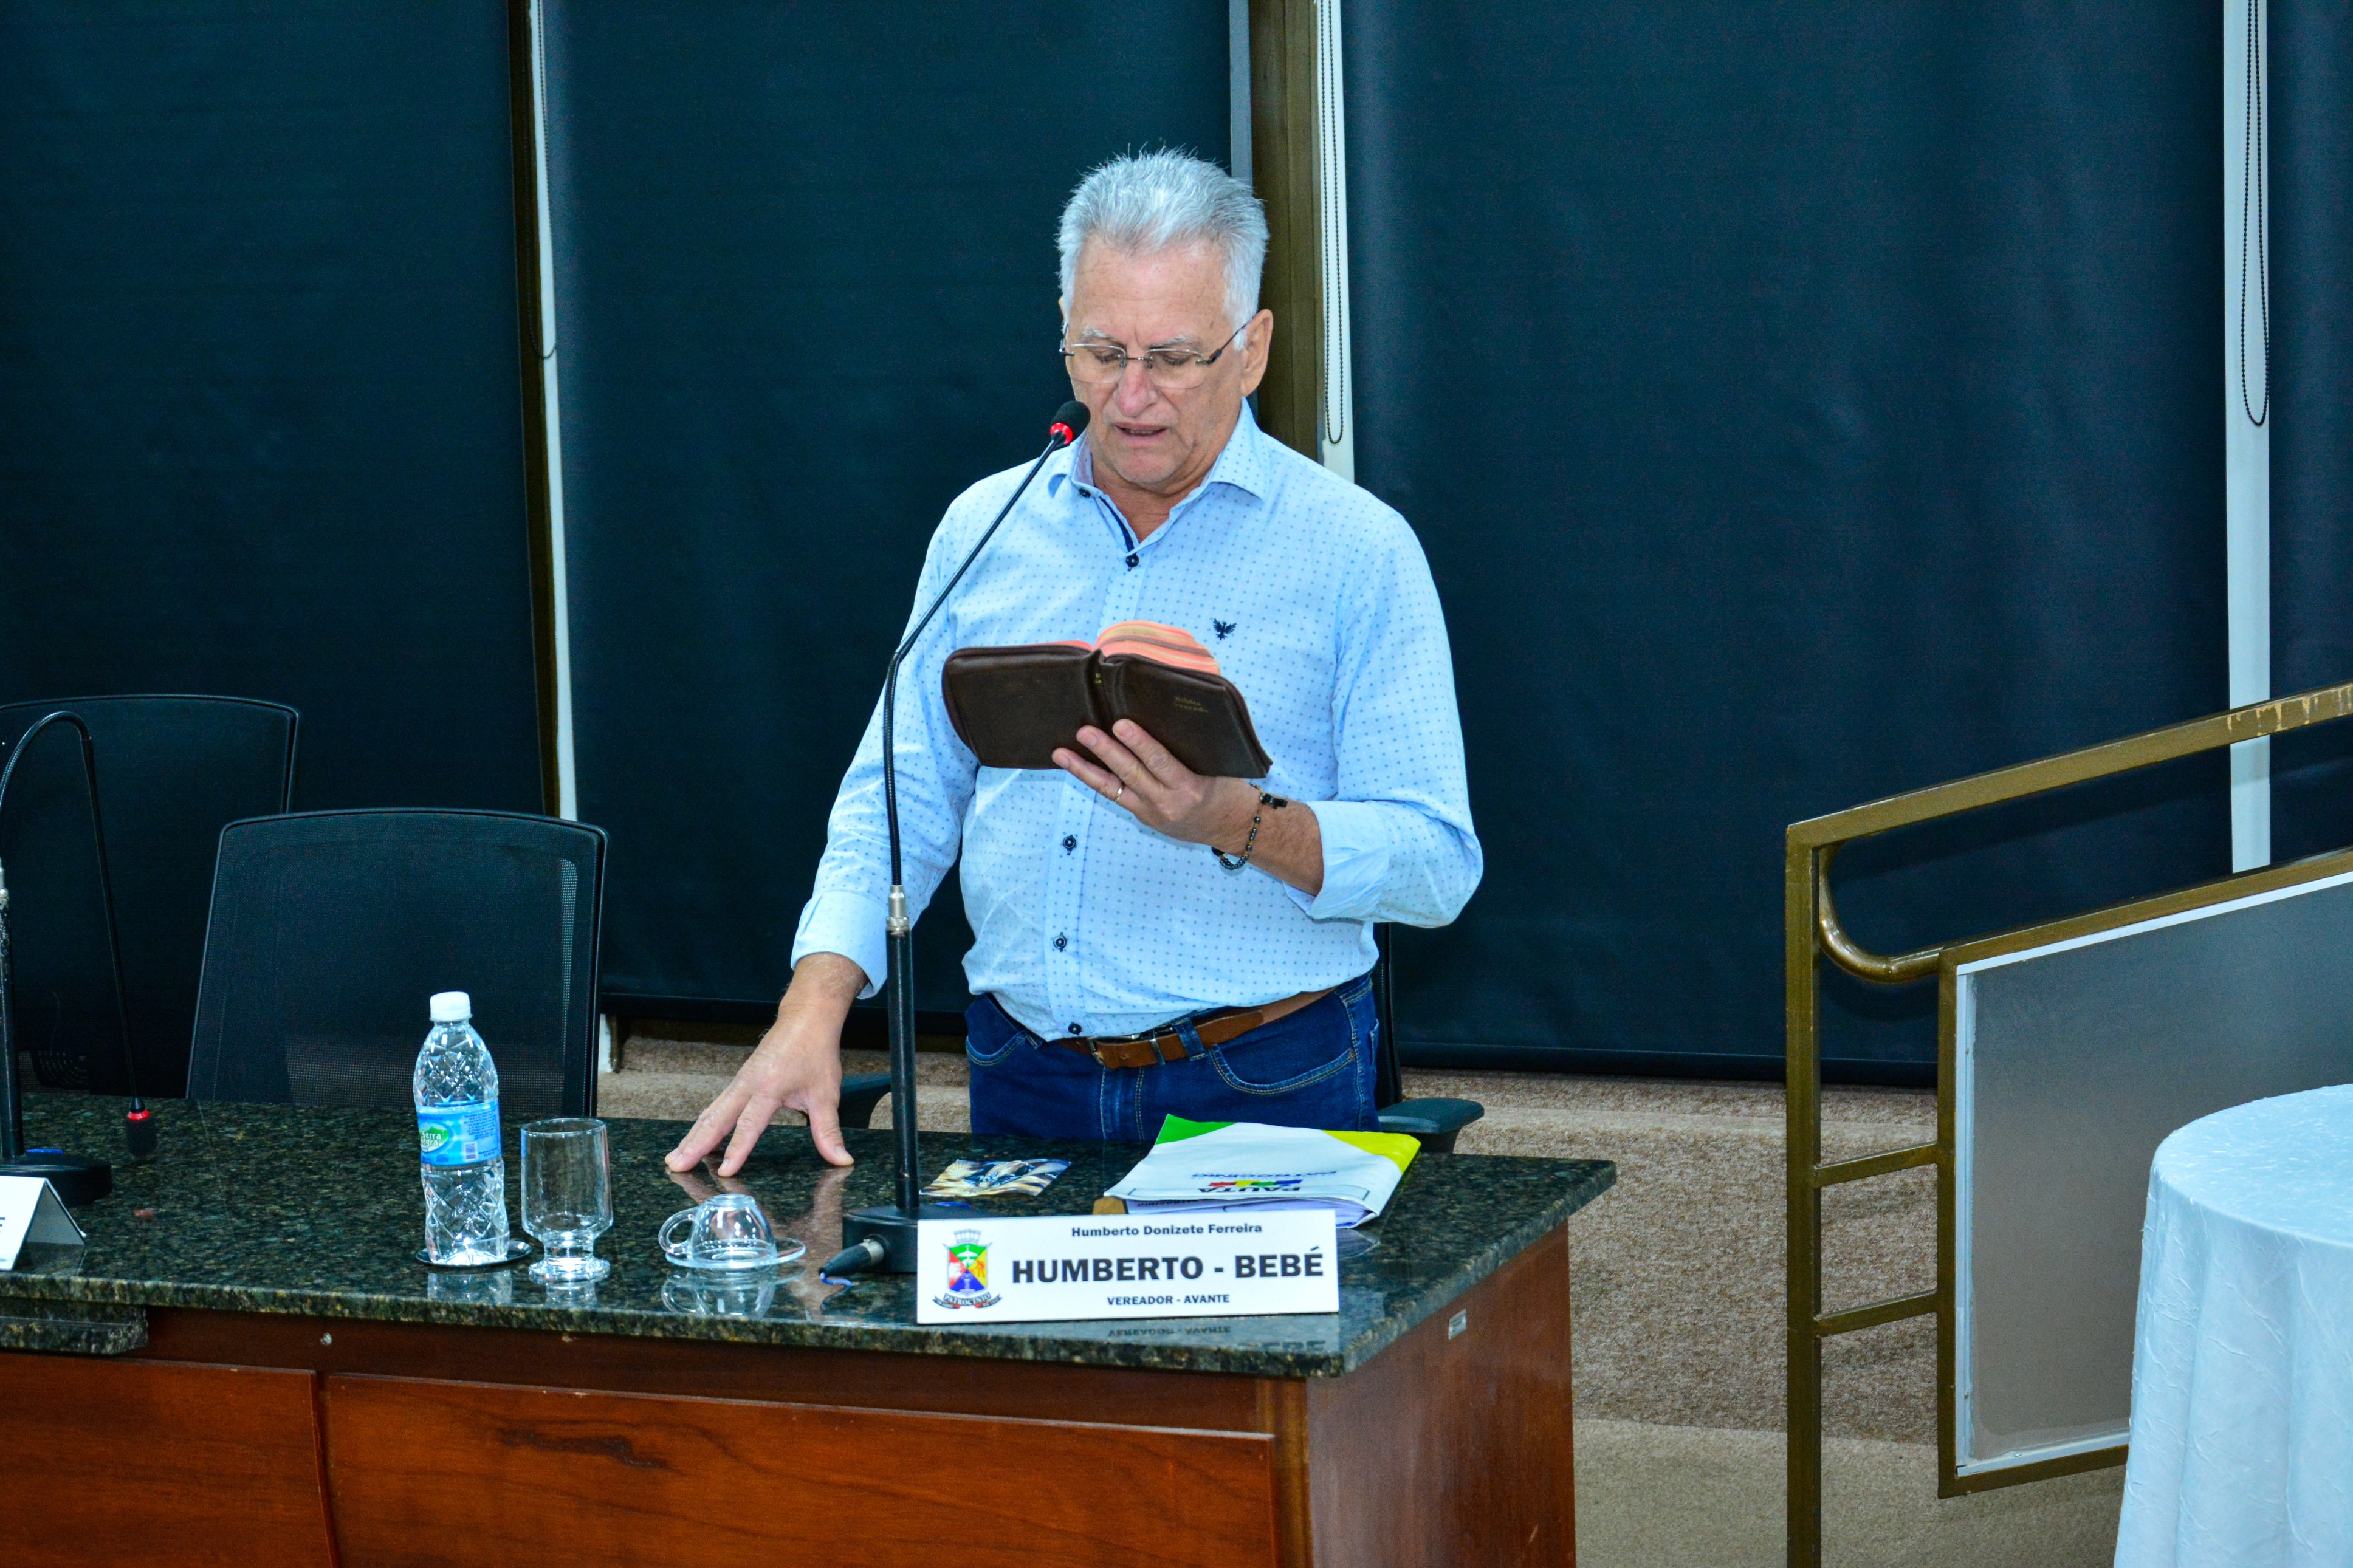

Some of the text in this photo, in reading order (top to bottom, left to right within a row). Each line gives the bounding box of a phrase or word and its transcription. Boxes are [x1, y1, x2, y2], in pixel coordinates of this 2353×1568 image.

[422, 1131, 441, 1140] Serra
[1071, 1223, 1263, 1236] Humberto Donizete Ferreira
[1012, 1255, 1204, 1284] HUMBERTO
[1235, 1245, 1324, 1278] BEBÉ
[1107, 1295, 1173, 1306] VEREADOR
[1184, 1294, 1230, 1303] AVANTE
